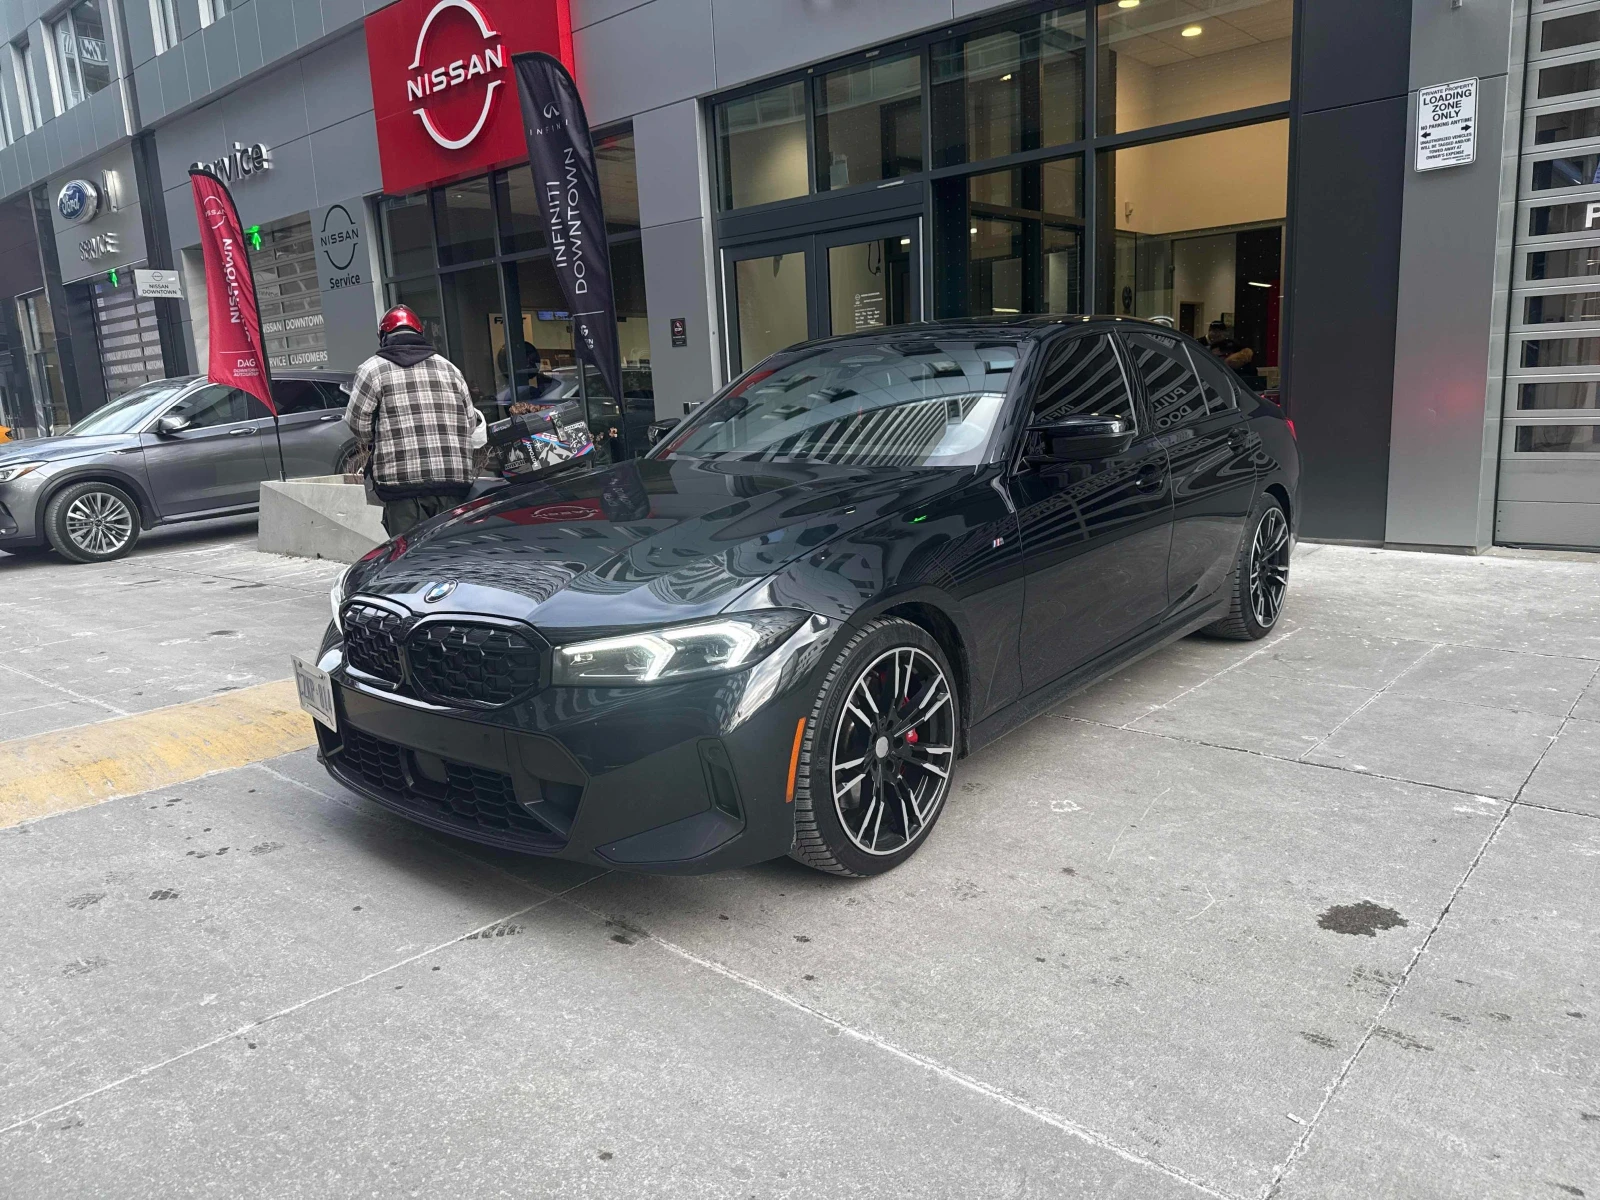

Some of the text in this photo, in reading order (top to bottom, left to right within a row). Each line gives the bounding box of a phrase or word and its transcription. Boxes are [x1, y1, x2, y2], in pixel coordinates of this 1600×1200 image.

[406, 44, 503, 101] NISSAN
[1422, 83, 1474, 97] PRIVATE PROPERTY
[1423, 89, 1472, 105] LOADING
[1432, 99, 1462, 113] ZONE
[1432, 109, 1461, 121] ONLY
[1429, 121, 1450, 129] PARKING
[1450, 117, 1473, 126] ANYTIME
[1452, 132, 1472, 140] VEHICLES
[546, 181, 568, 268] INFINITI
[563, 147, 588, 294] DOWNTOWN
[320, 228, 360, 247] NISSAN
[329, 273, 361, 289] Service
[285, 314, 325, 330] DOWNTOWN
[237, 358, 256, 369] DAG
[290, 351, 329, 365] CUSTOMERS
